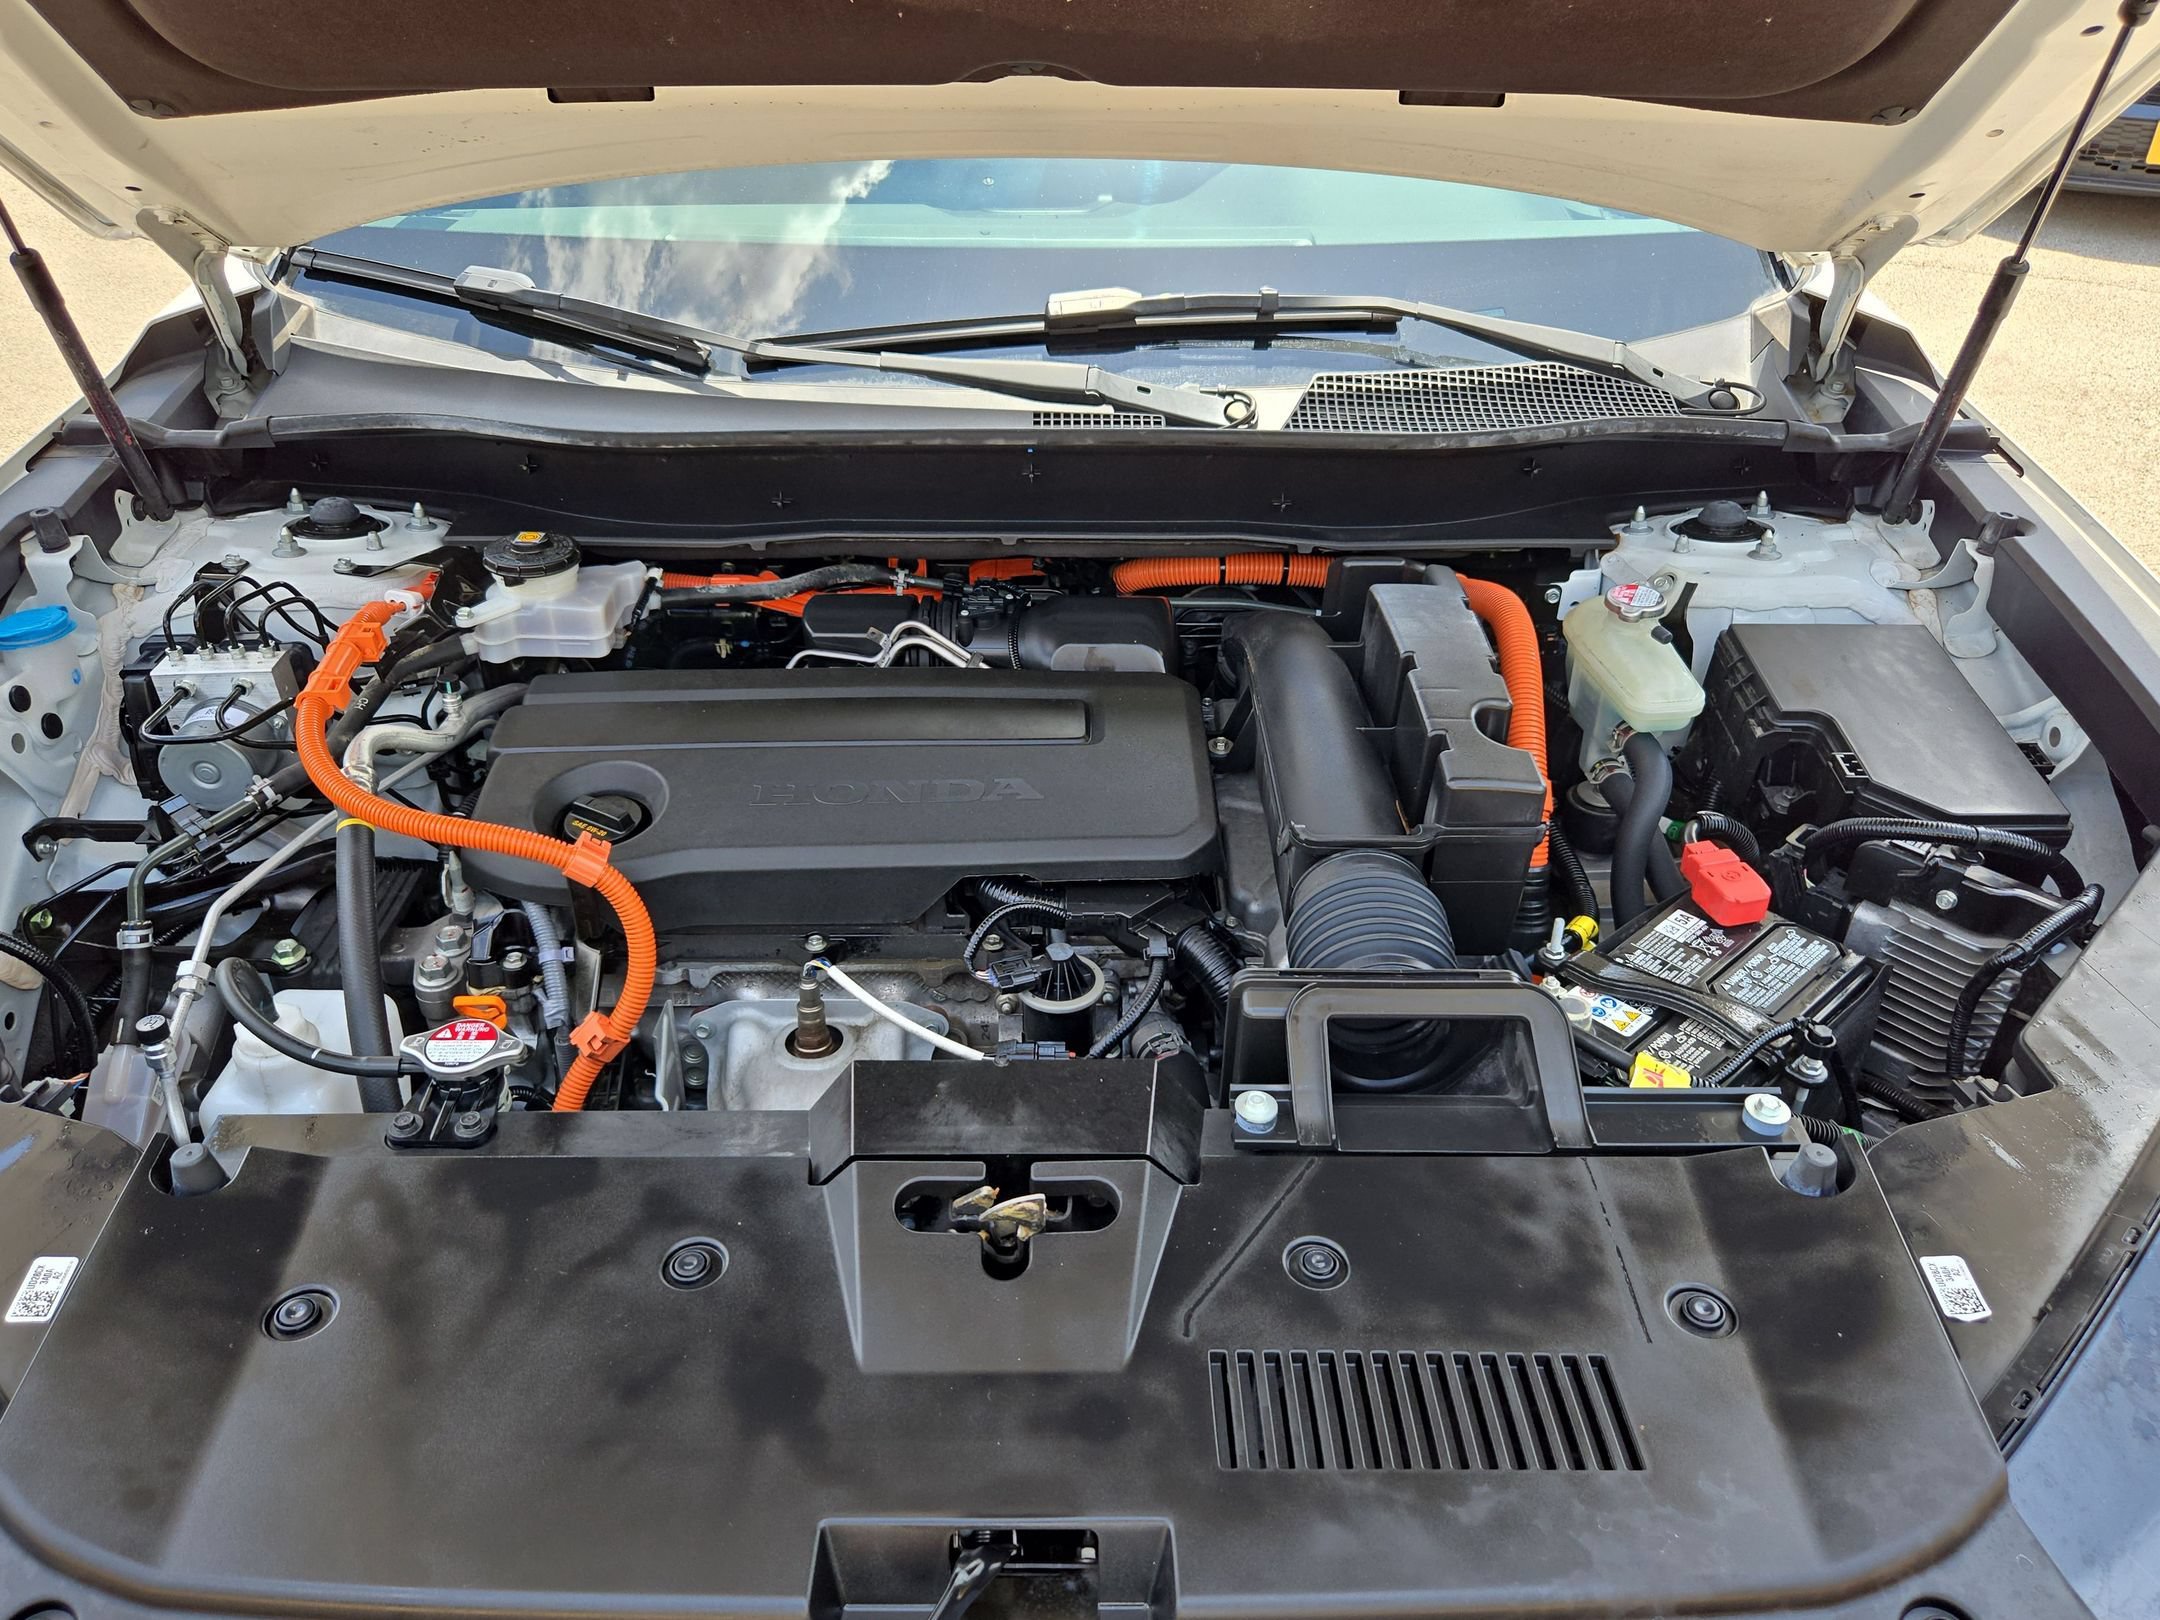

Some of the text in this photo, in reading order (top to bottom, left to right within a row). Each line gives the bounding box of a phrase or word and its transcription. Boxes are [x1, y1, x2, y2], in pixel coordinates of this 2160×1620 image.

[749, 778, 1045, 806] HONDA
[571, 820, 608, 837] SAE 0W-20
